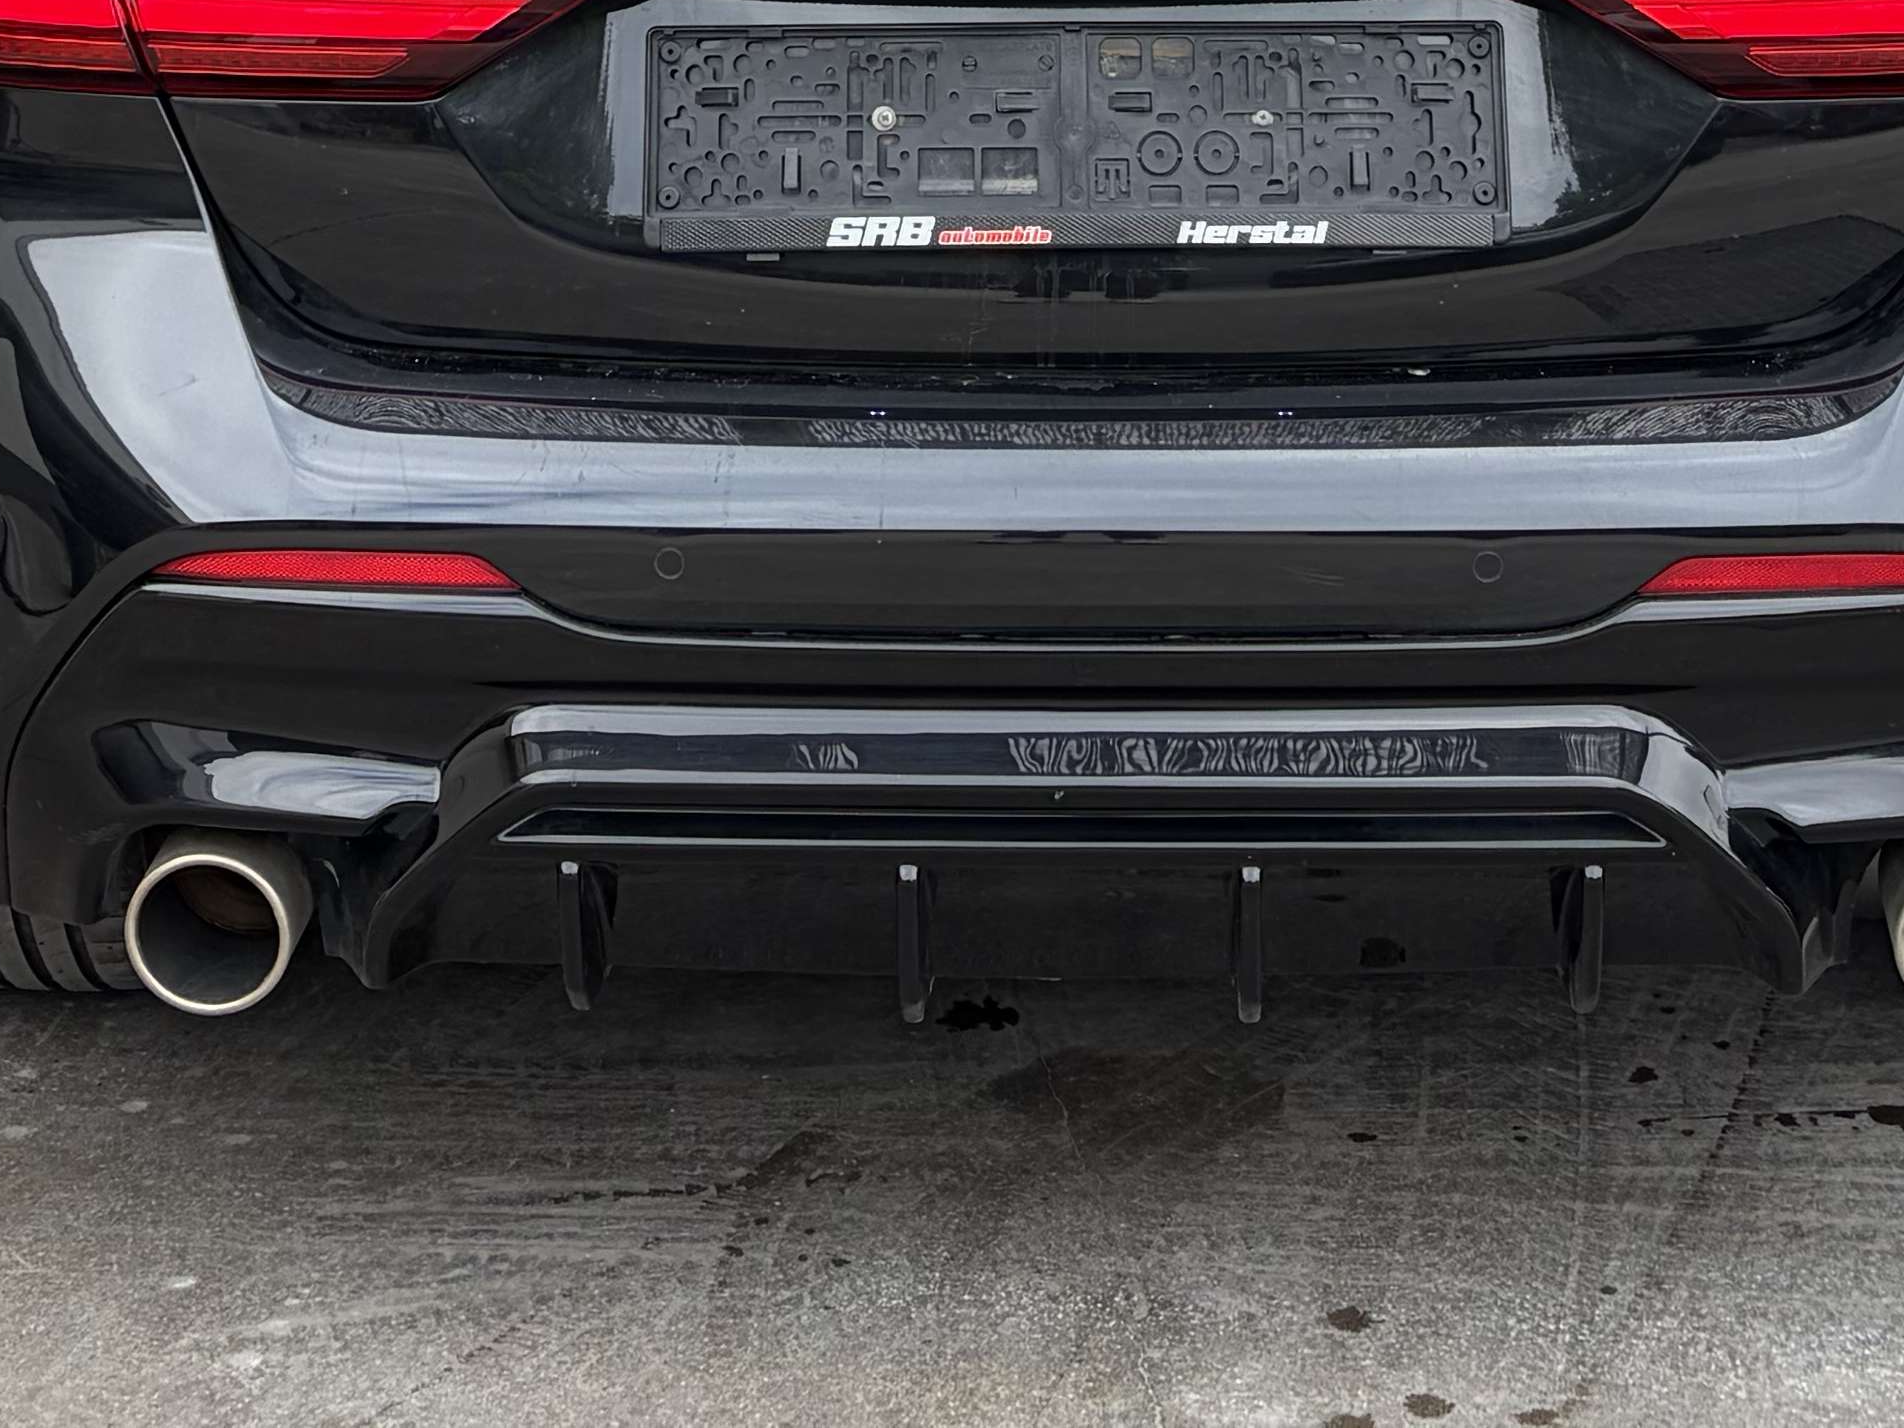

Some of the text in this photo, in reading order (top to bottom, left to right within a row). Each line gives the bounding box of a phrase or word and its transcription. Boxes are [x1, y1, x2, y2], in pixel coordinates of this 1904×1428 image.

[827, 216, 1053, 247] SRB automobile
[1176, 220, 1330, 245] Herstal
